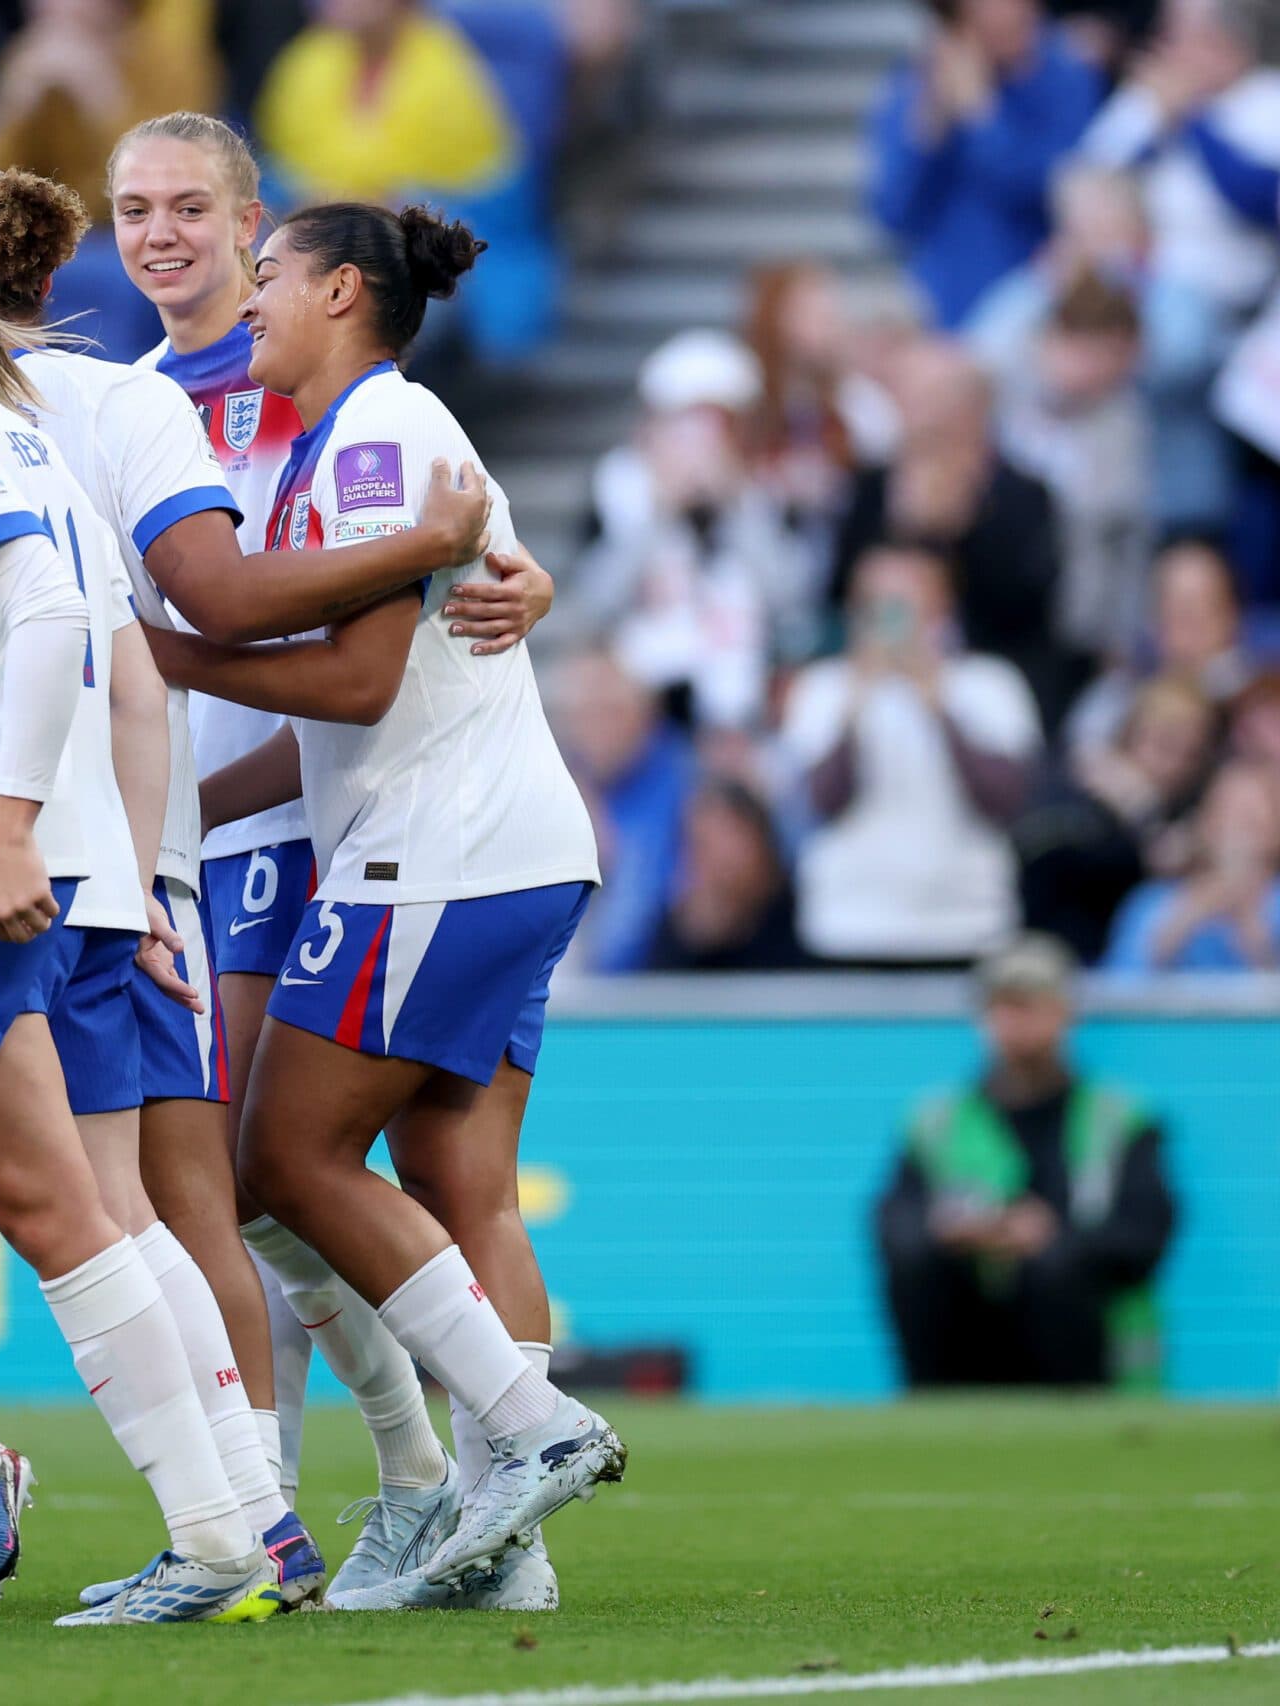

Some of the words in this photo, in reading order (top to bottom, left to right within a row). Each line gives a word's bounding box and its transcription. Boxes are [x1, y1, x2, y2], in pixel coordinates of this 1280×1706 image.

[343, 481, 395, 495] EUROPEAN
[343, 489, 397, 503] QUALIFIERS
[335, 523, 412, 537] FOUNDATION
[242, 842, 279, 914] 6
[299, 900, 355, 975] 5
[215, 1367, 240, 1388] ENG
